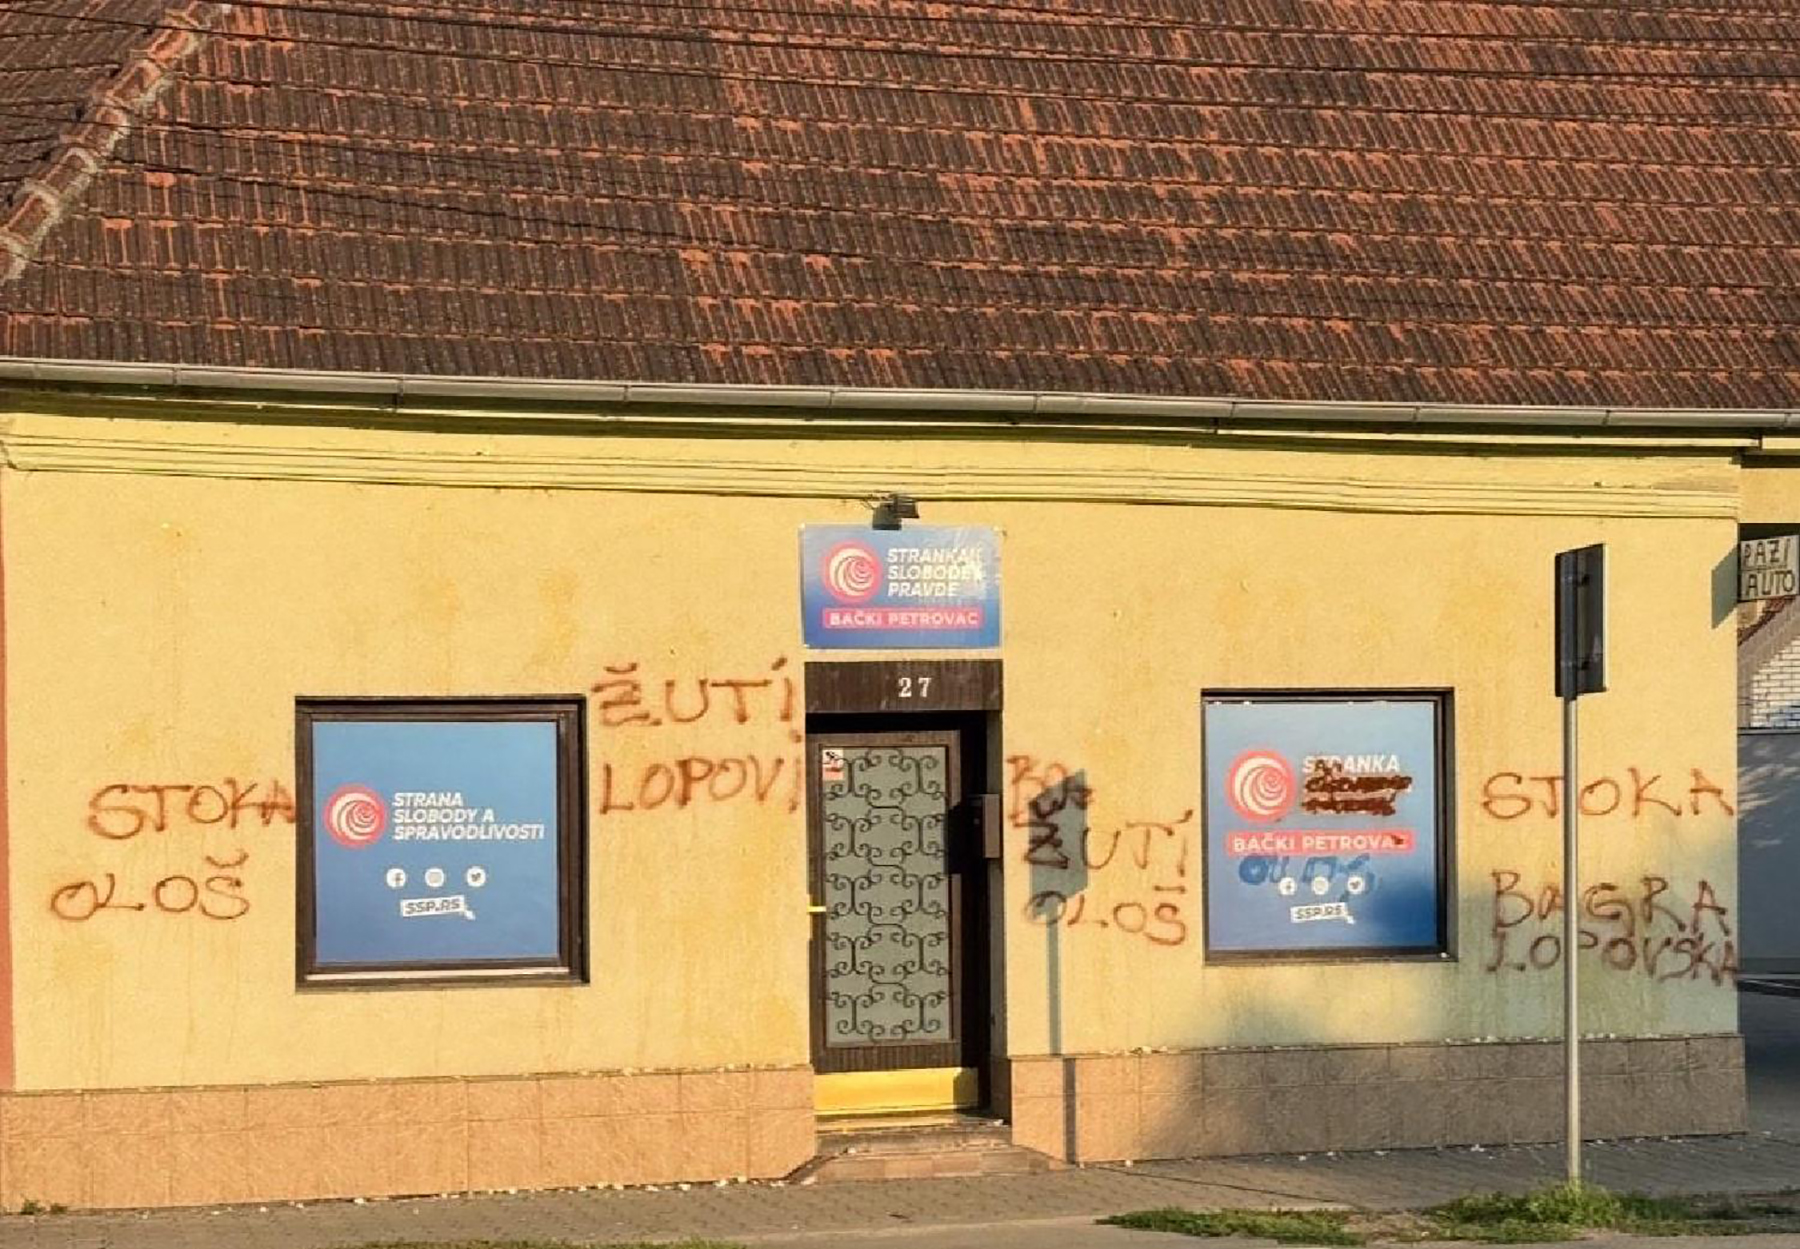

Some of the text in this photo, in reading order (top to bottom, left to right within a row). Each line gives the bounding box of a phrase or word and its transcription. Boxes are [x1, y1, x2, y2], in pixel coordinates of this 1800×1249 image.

[887, 582, 961, 597] PRAVDE
[1745, 569, 1796, 598] AUTO
[829, 610, 979, 626] BAČKI PETROVAC
[898, 677, 932, 698] 27
[392, 791, 464, 808] STRANA
[1482, 767, 1735, 820] STOKA
[88, 777, 296, 840] STOKA
[392, 808, 496, 824] SLOBODY A
[392, 823, 545, 841] SPRAVODLIVOSTI
[1233, 832, 1295, 852] BAČKI
